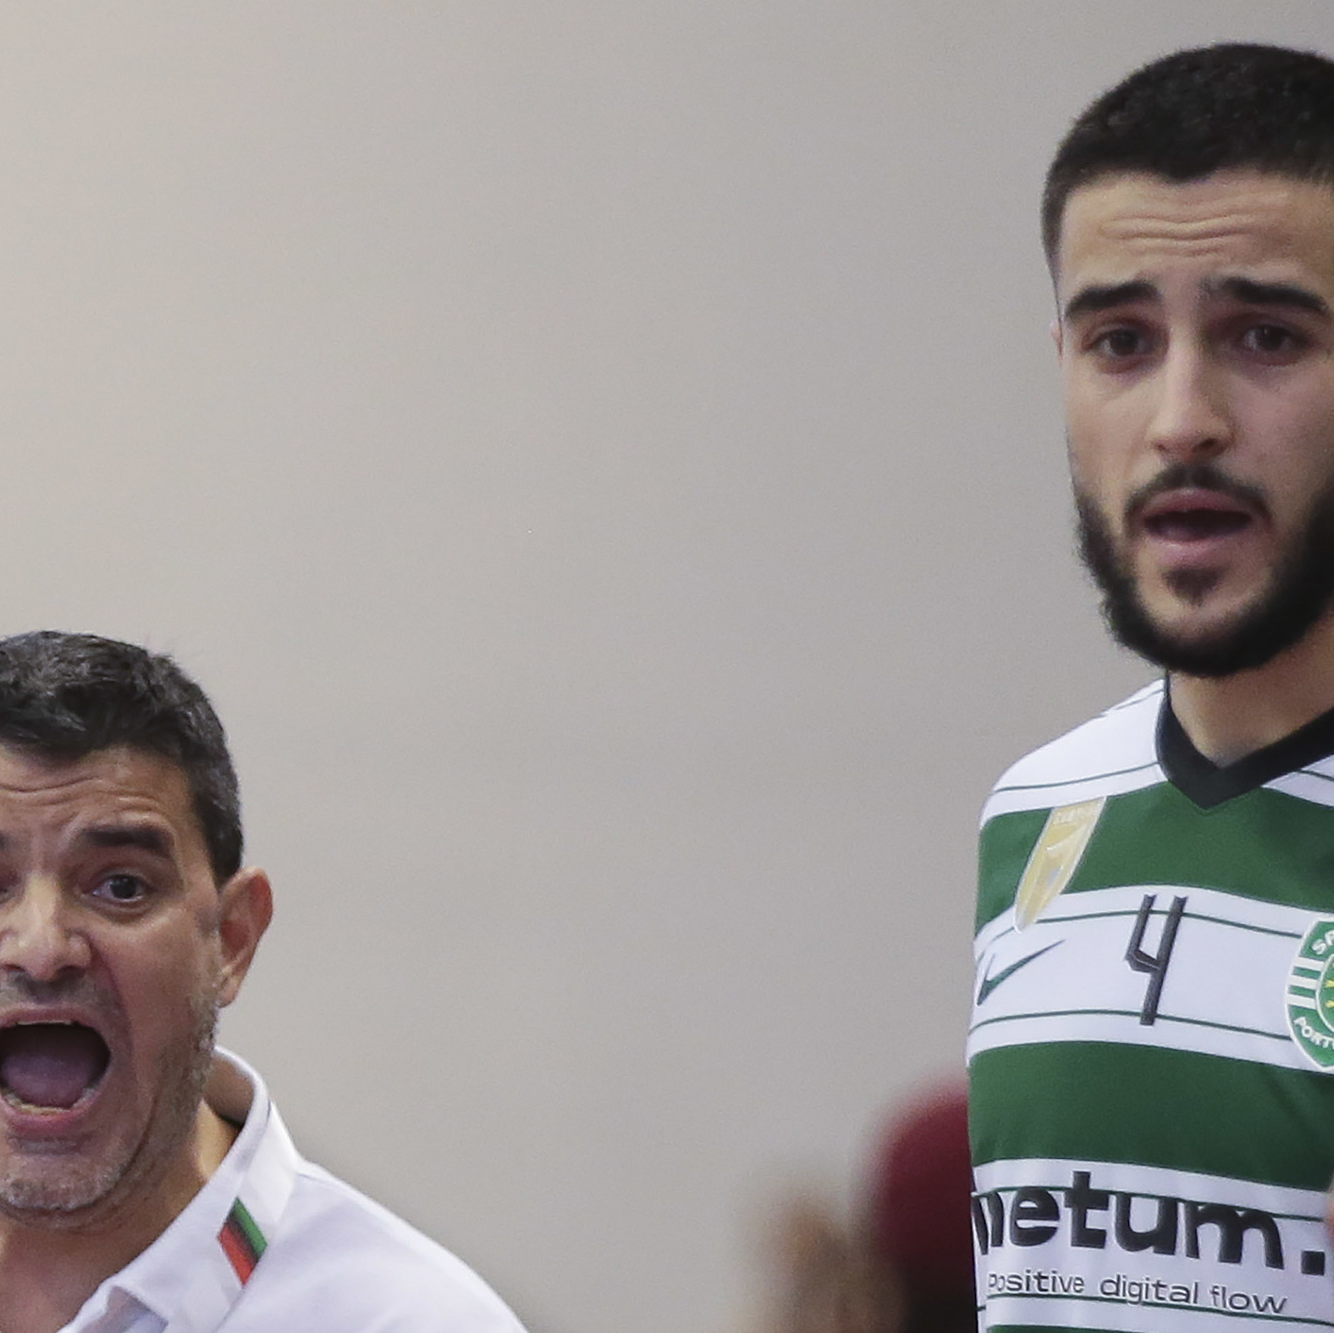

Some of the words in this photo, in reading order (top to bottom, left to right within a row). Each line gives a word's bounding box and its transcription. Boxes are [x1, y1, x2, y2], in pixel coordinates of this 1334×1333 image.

[1124, 893, 1189, 1026] 4
[1099, 1273, 1198, 1306] digital
[1208, 1284, 1287, 1314] flow
